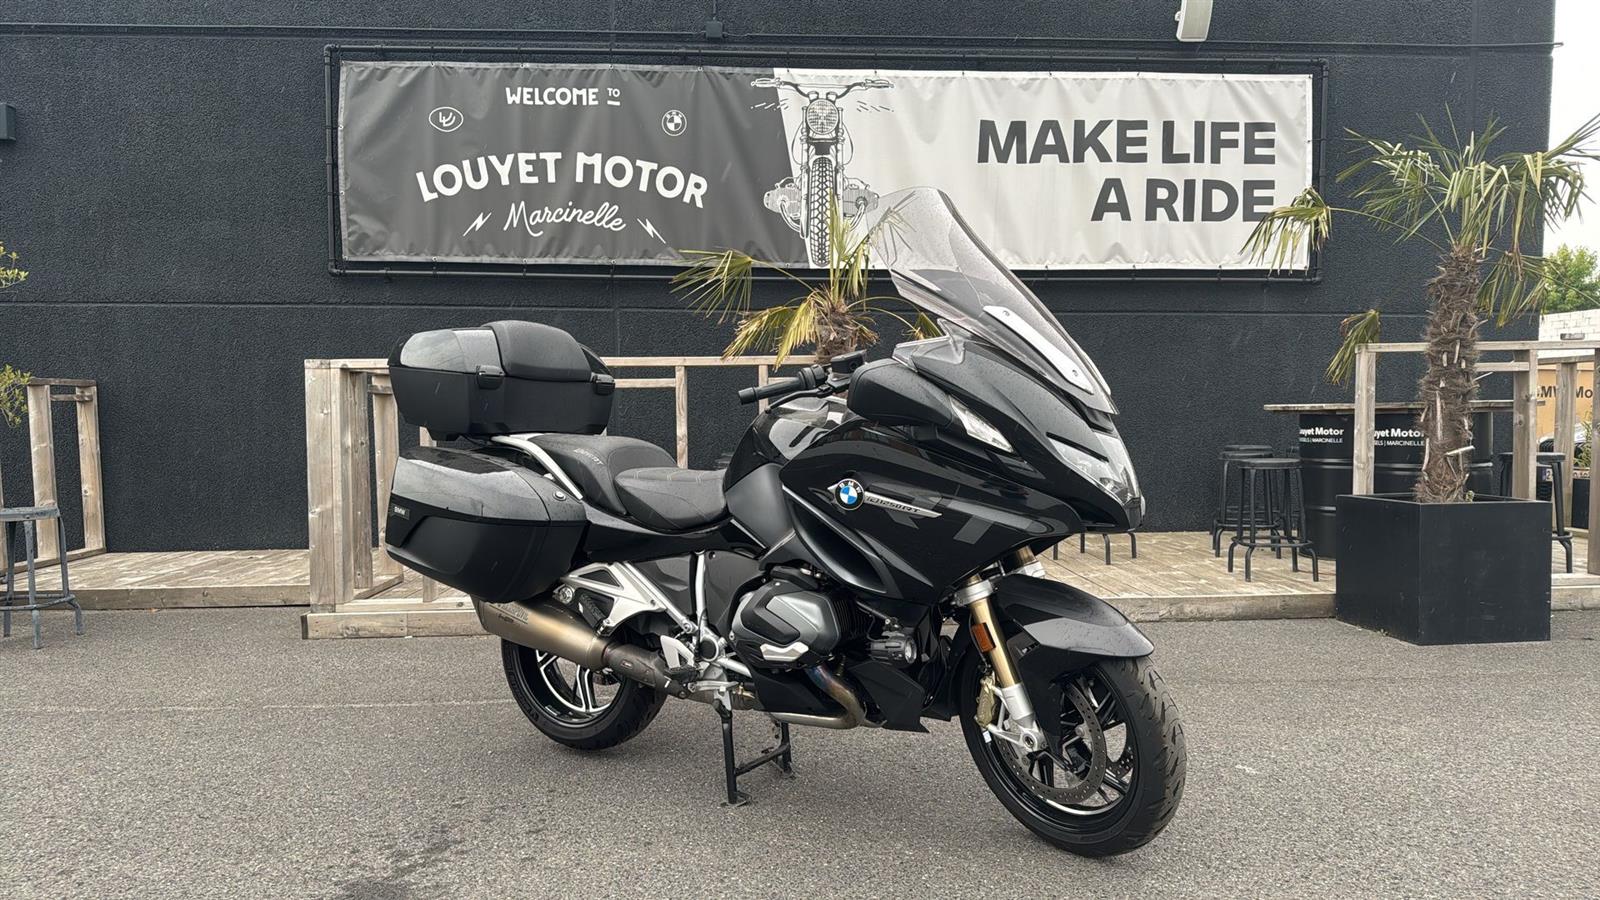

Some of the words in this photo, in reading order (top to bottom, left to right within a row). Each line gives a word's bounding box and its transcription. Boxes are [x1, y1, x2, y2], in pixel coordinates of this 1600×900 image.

[505, 87, 599, 106] WELCOME
[607, 88, 621, 98] TO
[977, 119, 1148, 164] MAKE
[1162, 120, 1276, 165] LIFE
[415, 152, 562, 202] LOUYET
[575, 151, 708, 209] MOTOR
[1090, 177, 1131, 222] A
[1145, 178, 1276, 222] RIDE
[503, 201, 627, 237] Marcinelle
[1315, 427, 1344, 436] Motor
